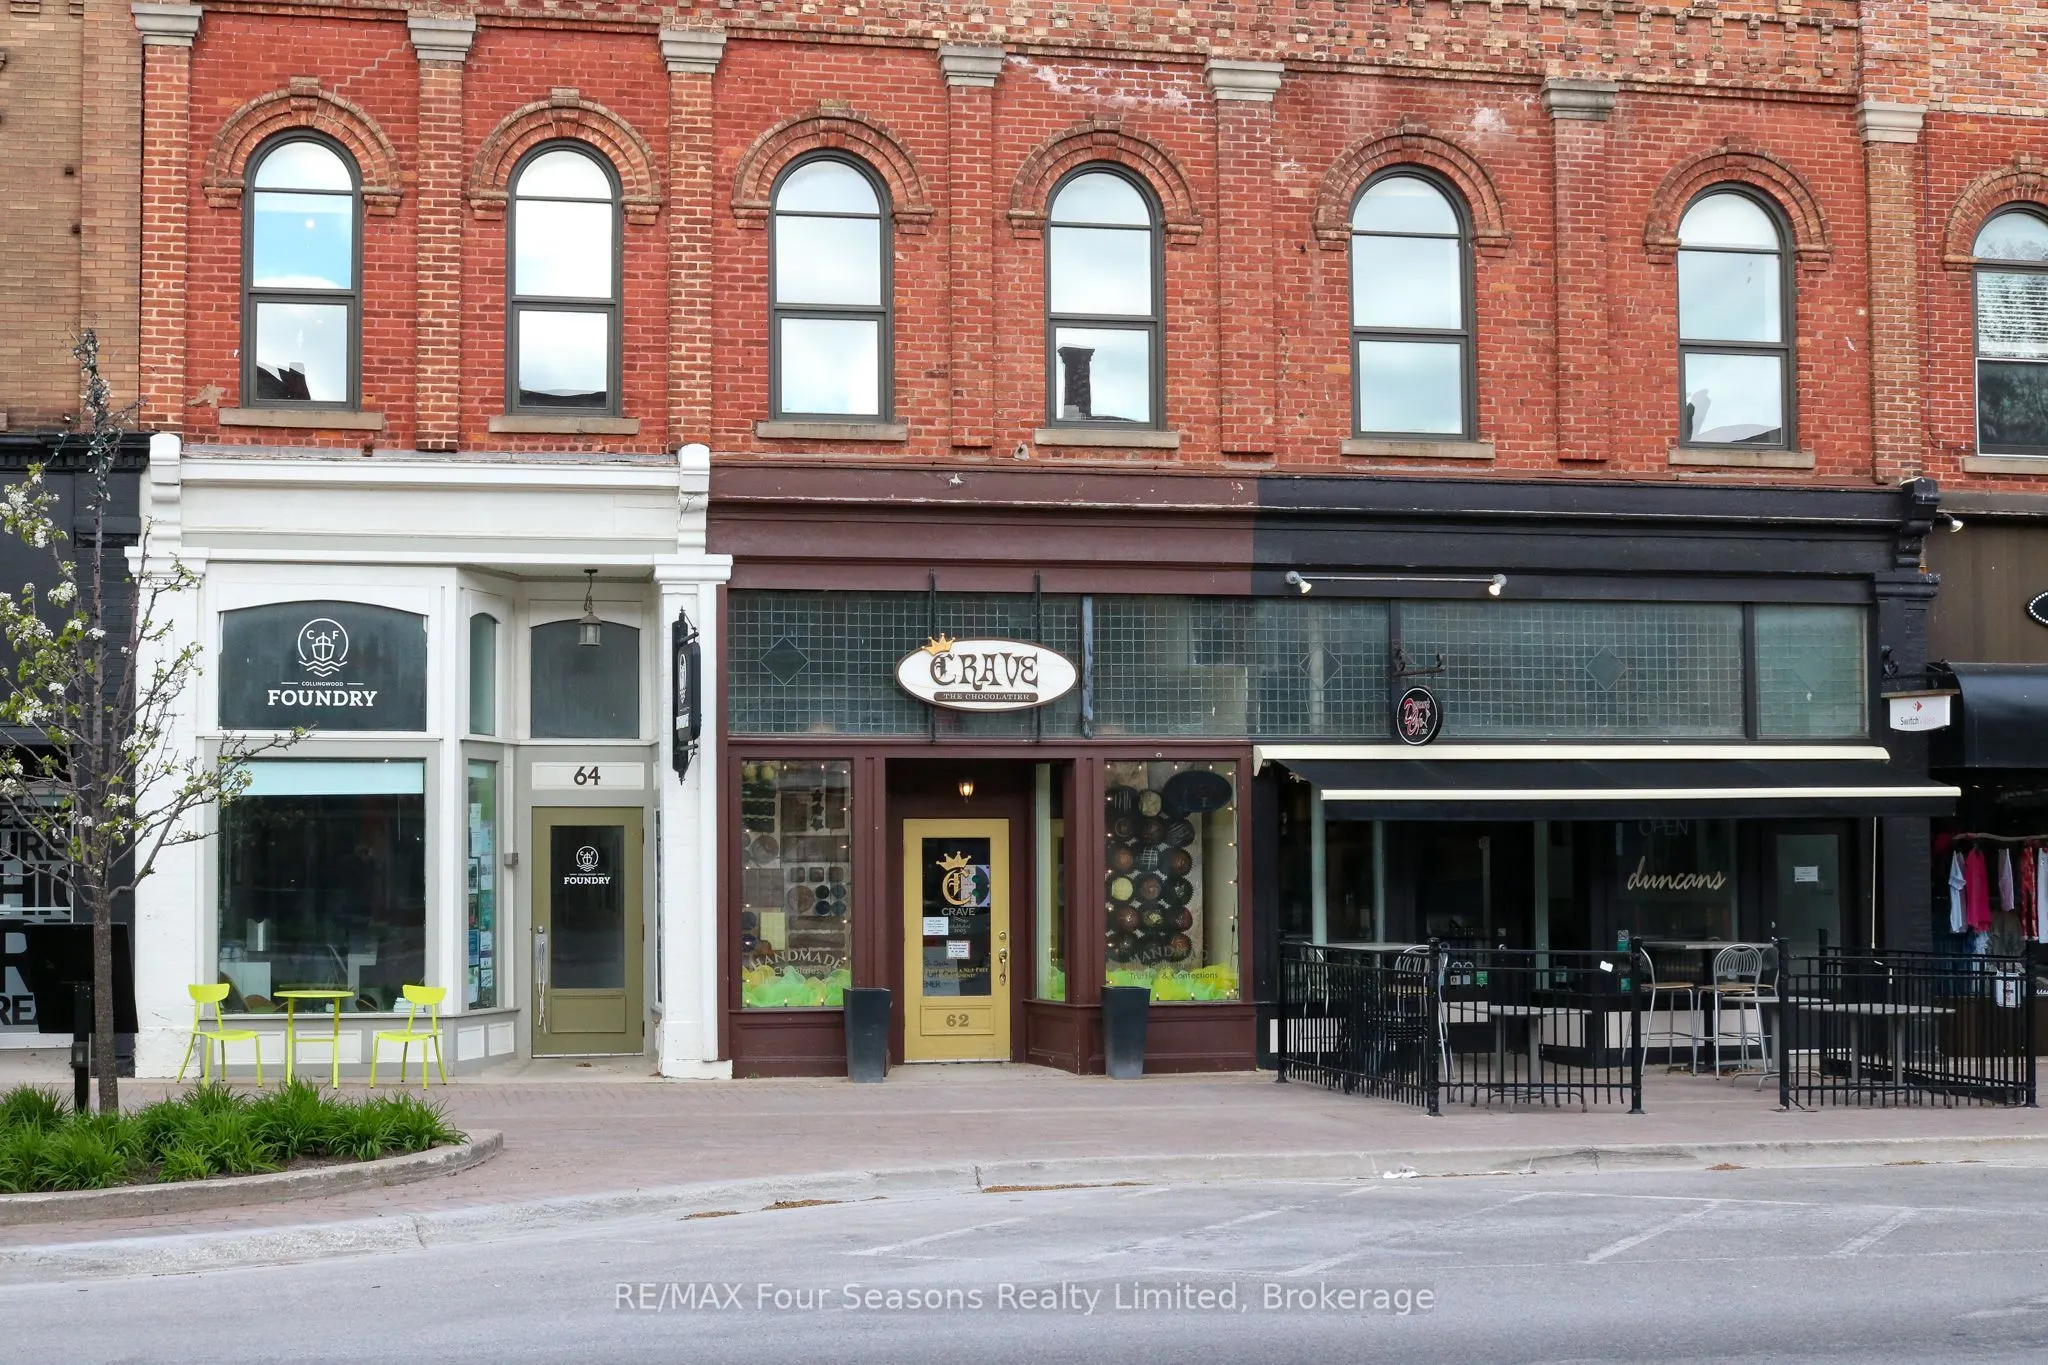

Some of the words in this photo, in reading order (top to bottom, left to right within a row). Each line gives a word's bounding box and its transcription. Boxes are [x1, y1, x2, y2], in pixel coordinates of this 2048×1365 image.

[929, 652, 1039, 691] CRAVE
[267, 689, 378, 707] FOUNDRY
[573, 765, 601, 786] 64
[563, 876, 611, 885] FOUNDRY
[1627, 855, 1727, 890] duncans
[941, 907, 976, 916] CRAVE
[750, 949, 844, 970] HANDMADE
[946, 1013, 969, 1027] 62
